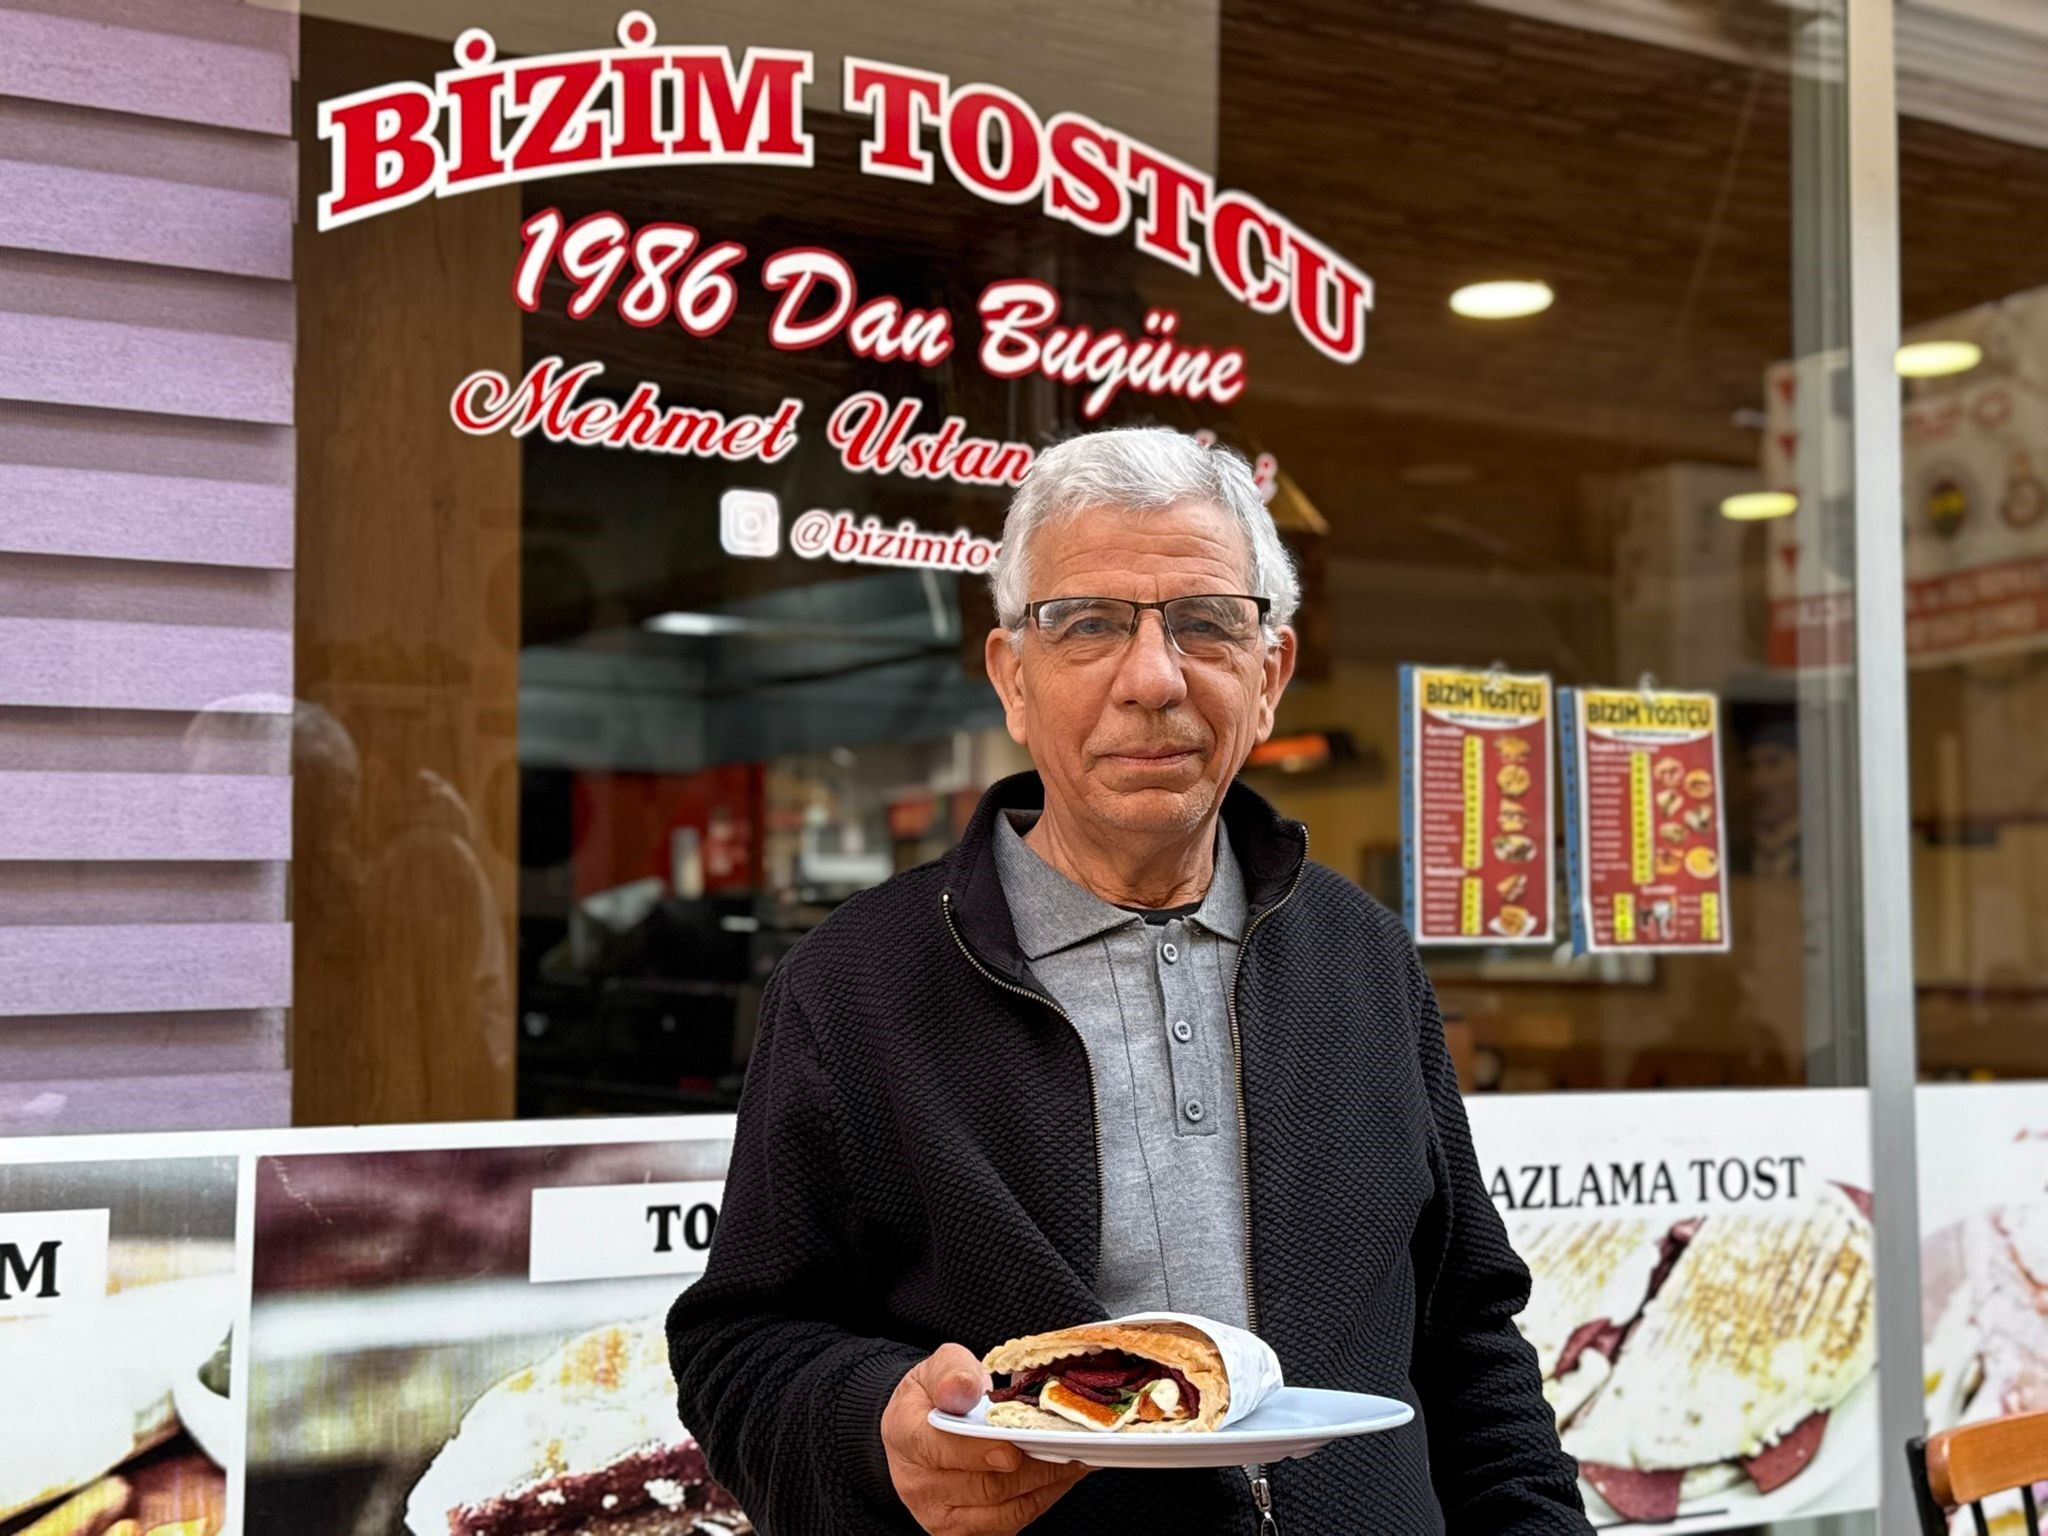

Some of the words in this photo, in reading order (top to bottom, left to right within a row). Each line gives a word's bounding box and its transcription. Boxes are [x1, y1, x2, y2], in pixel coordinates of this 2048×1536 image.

[318, 10, 815, 232] BİZİM
[512, 207, 748, 337] 1986
[762, 246, 954, 365] Dan
[978, 279, 1247, 419] Bugüne
[450, 356, 803, 463] Mehmet
[827, 391, 1036, 488] Ustan
[790, 510, 1008, 575] @bizimto
[1490, 1160, 1679, 1210] AZLAMA
[1688, 1156, 1807, 1200] TOST
[646, 1202, 719, 1252] TO
[0, 1240, 63, 1300] M
